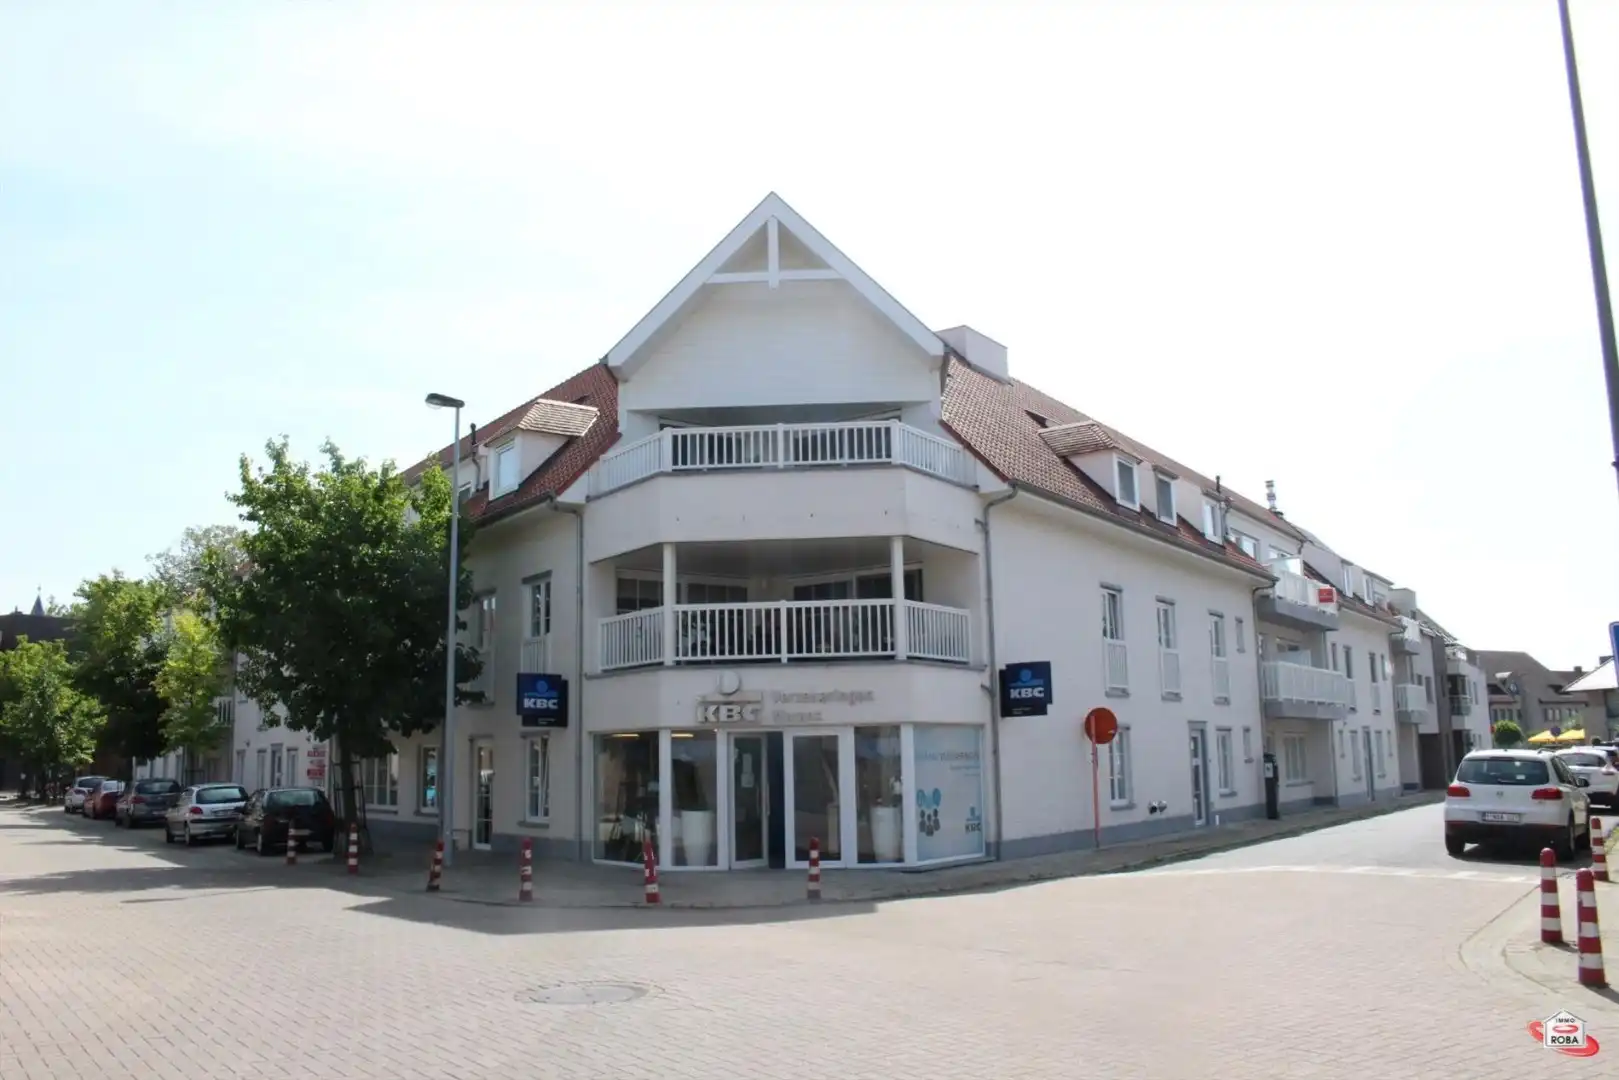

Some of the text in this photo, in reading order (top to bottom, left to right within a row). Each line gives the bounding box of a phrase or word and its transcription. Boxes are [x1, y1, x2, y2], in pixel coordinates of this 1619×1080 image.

[1009, 687, 1045, 699] KBC
[523, 697, 559, 709] KBC
[696, 704, 761, 723] KBC
